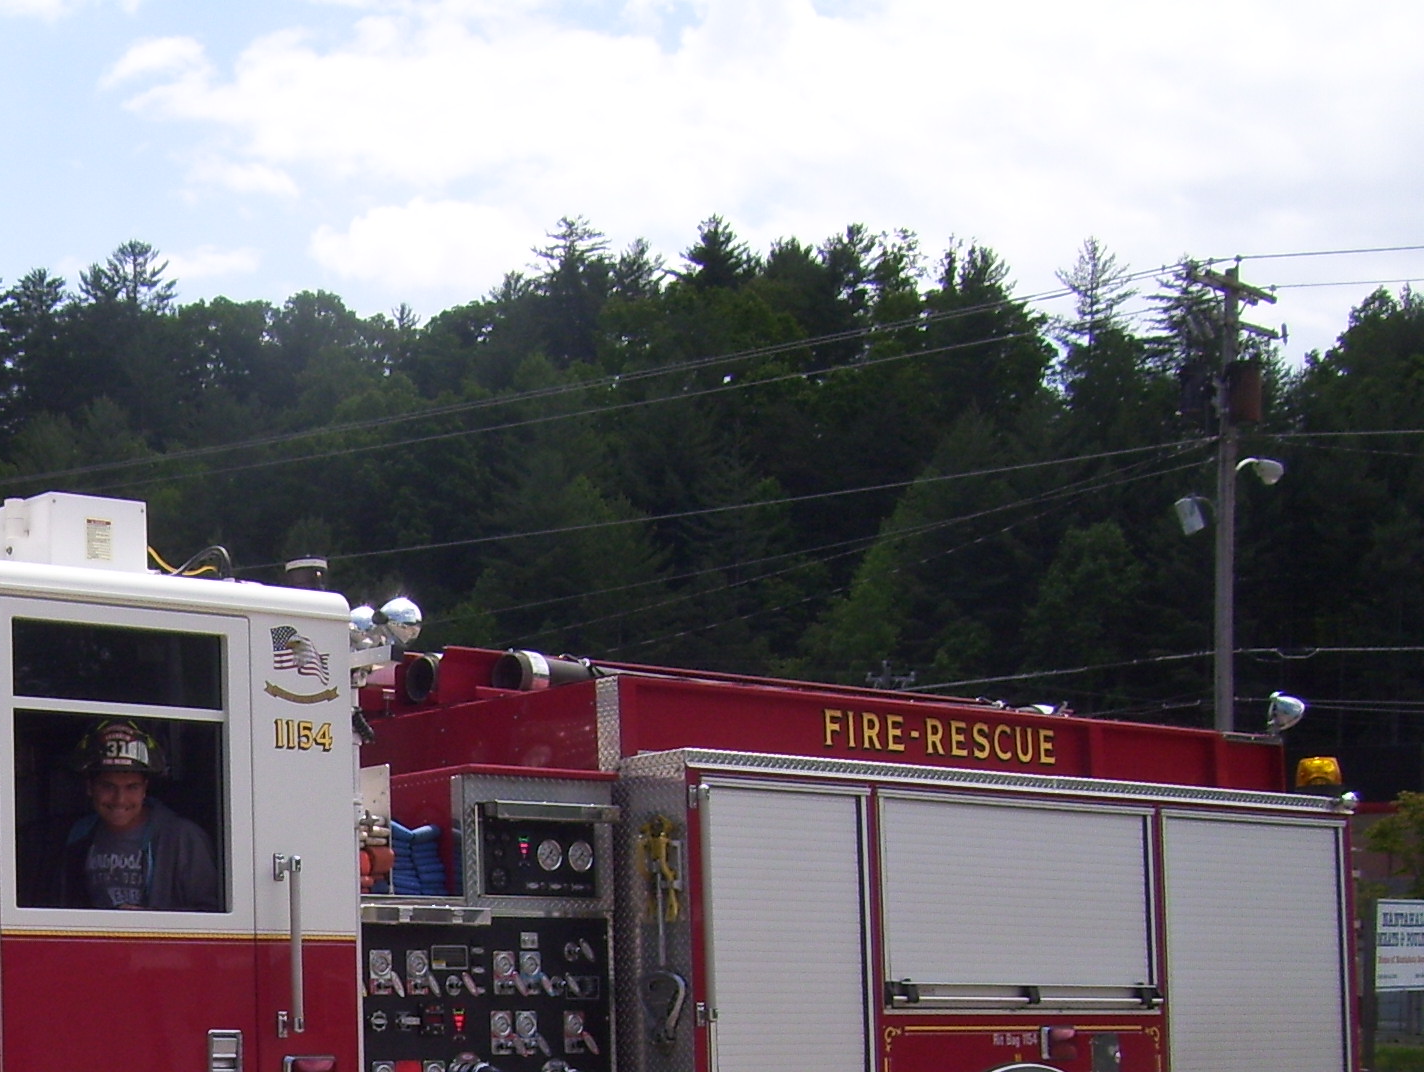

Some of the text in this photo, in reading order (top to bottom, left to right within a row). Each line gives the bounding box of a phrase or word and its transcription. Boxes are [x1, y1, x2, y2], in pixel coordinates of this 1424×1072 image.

[106, 740, 129, 758] 31
[273, 718, 333, 752] 1154
[824, 708, 1056, 765] FIRE-RESCUE
